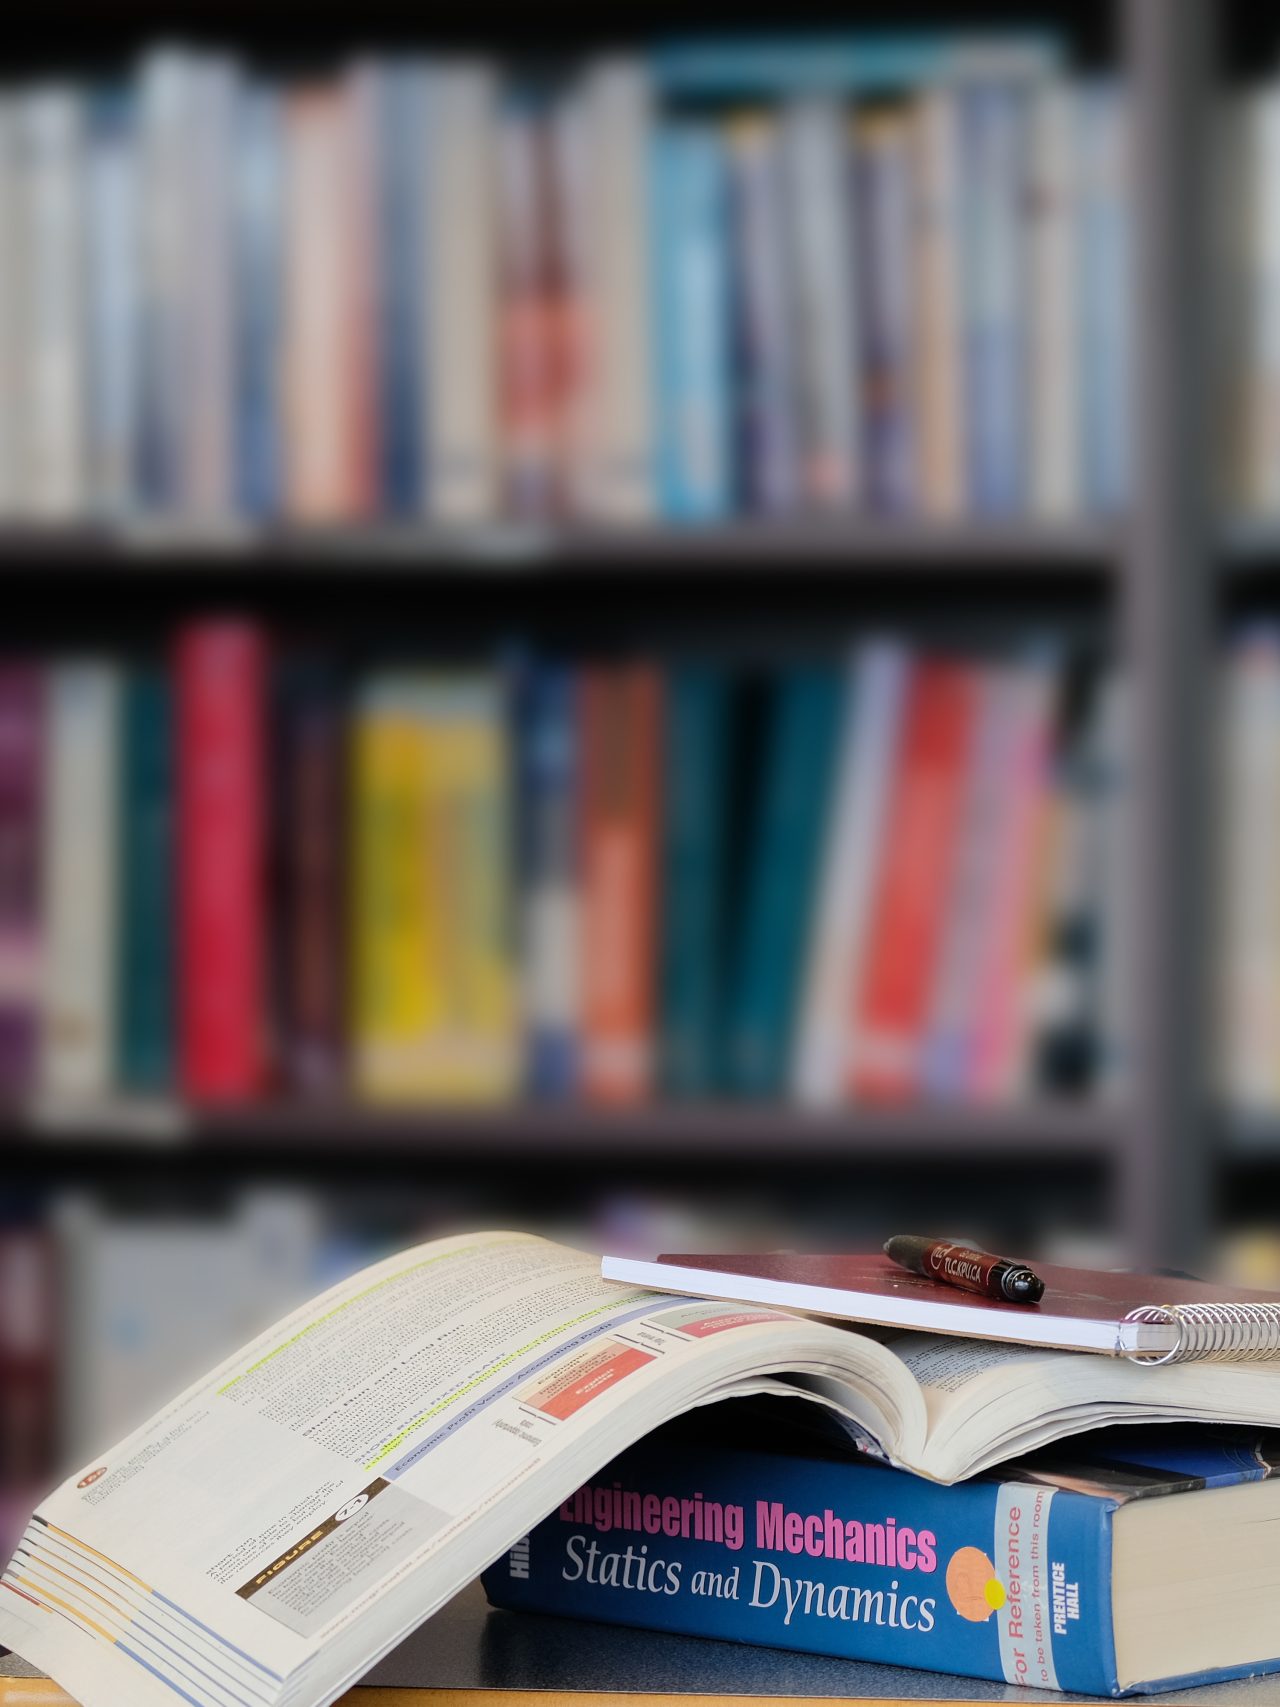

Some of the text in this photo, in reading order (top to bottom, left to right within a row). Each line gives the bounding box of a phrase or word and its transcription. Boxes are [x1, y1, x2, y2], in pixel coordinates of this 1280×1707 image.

[393, 1431, 447, 1471] Economic
[446, 1408, 476, 1430] Profit
[476, 1381, 513, 1407] Versus
[517, 1340, 579, 1378] Accounting
[560, 1483, 744, 1552] Engineering
[756, 1500, 938, 1574] Mechanics
[1031, 1490, 1045, 1528] room
[256, 1530, 324, 1584] FIGURE
[342, 1498, 362, 1516] 7-1
[1030, 1533, 1039, 1560] this
[562, 1535, 936, 1633] Statics and Dynamics
[1006, 1506, 1023, 1639] Reference
[1031, 1565, 1040, 1598] from
[1052, 1562, 1067, 1635] PRENTICE
[1034, 1603, 1043, 1642] taken
[1066, 1582, 1080, 1620] HALL
[1036, 1647, 1046, 1664] be
